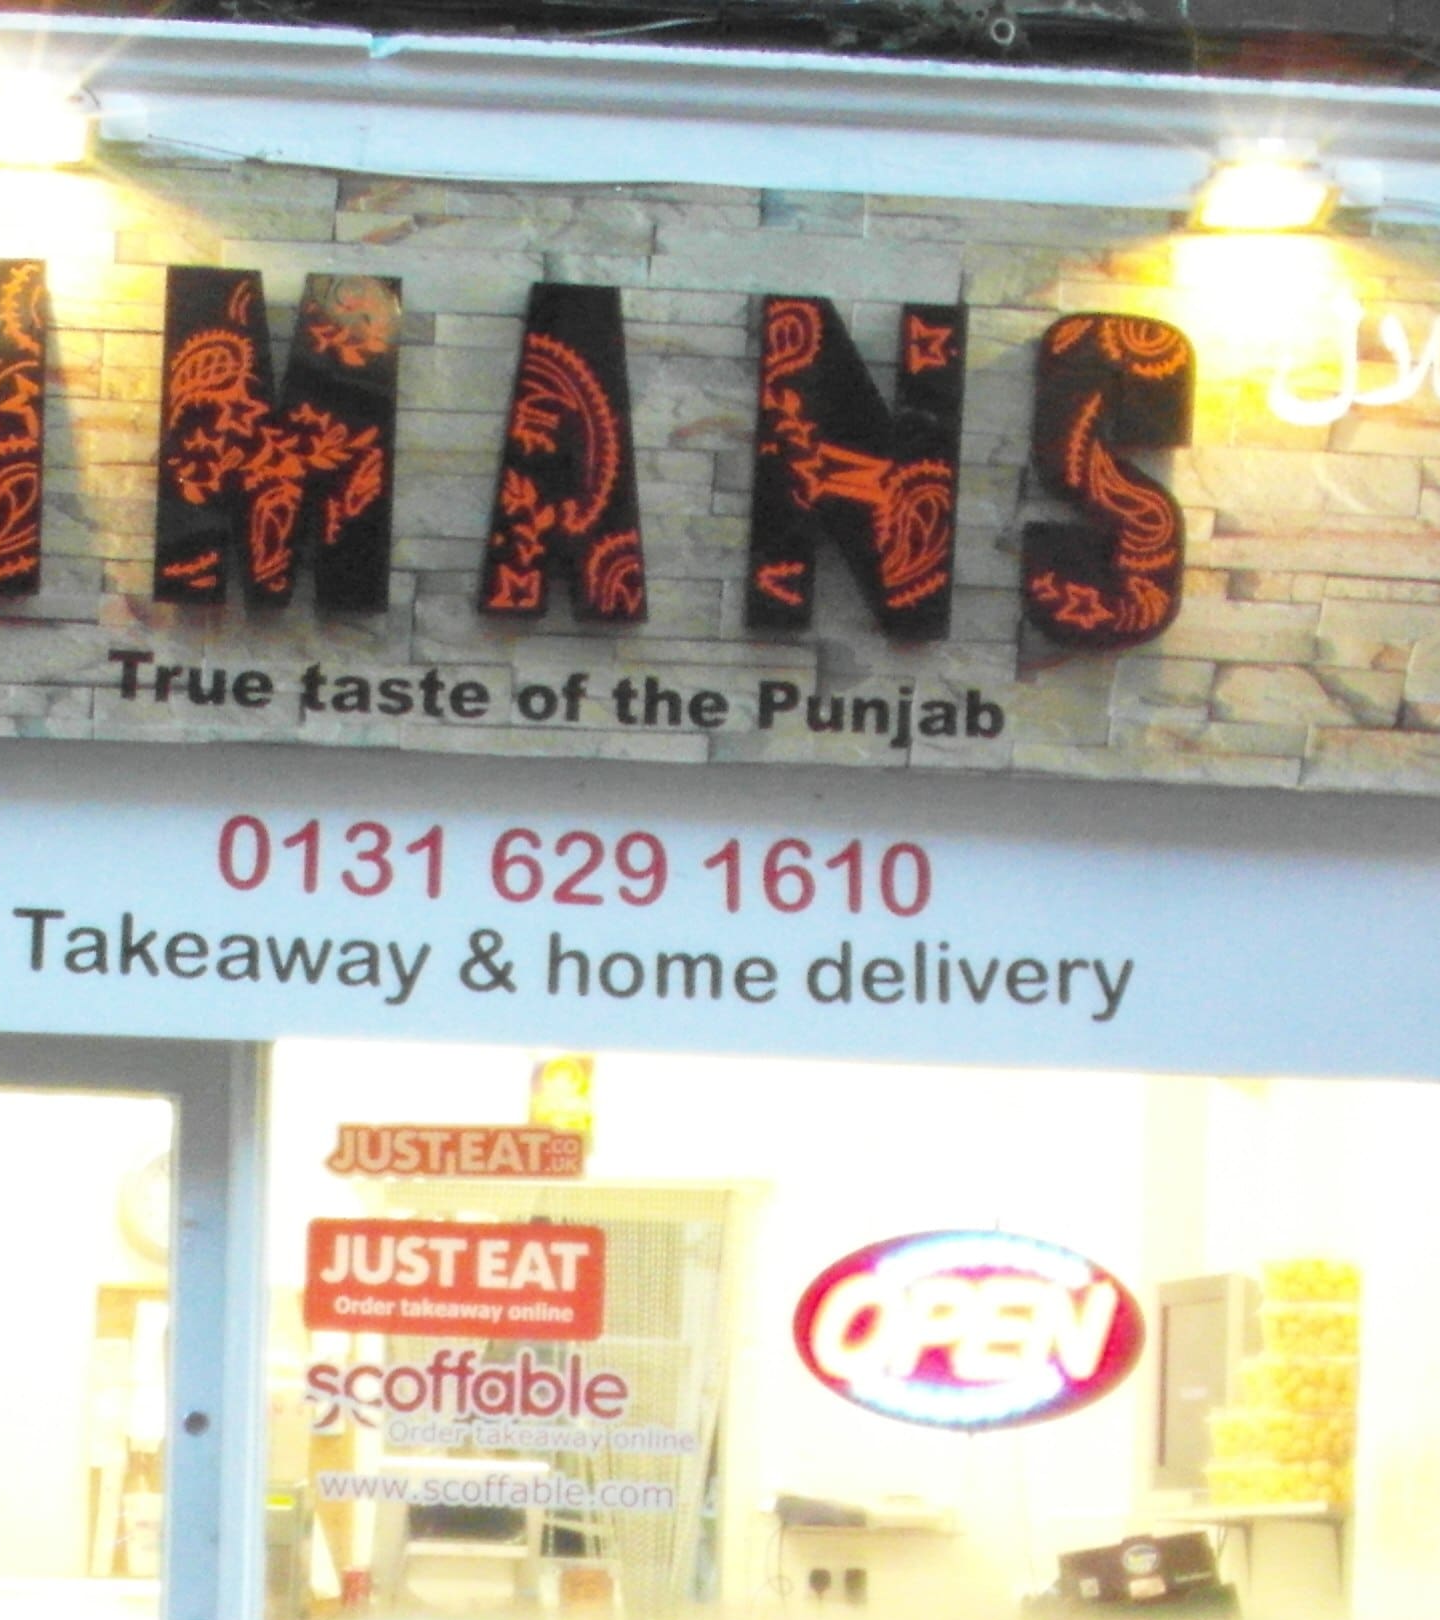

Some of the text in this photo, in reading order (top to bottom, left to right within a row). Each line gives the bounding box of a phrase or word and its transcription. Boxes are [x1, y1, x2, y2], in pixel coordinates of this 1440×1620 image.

[107, 649, 1005, 749] True taste of the Punjab
[216, 815, 933, 918] 0131 629 1610
[12, 906, 1136, 1022] Takeaway & home delivery
[328, 1129, 452, 1173] JUST
[461, 1131, 551, 1173] EAT
[319, 1234, 590, 1292] JUST EAT
[333, 1295, 575, 1323] Order takeaway online
[811, 1272, 1118, 1384] OPEN
[305, 1349, 630, 1428] scoffable
[387, 1418, 696, 1453] Order takeaway online
[320, 1473, 675, 1508] www.scoffable.com
